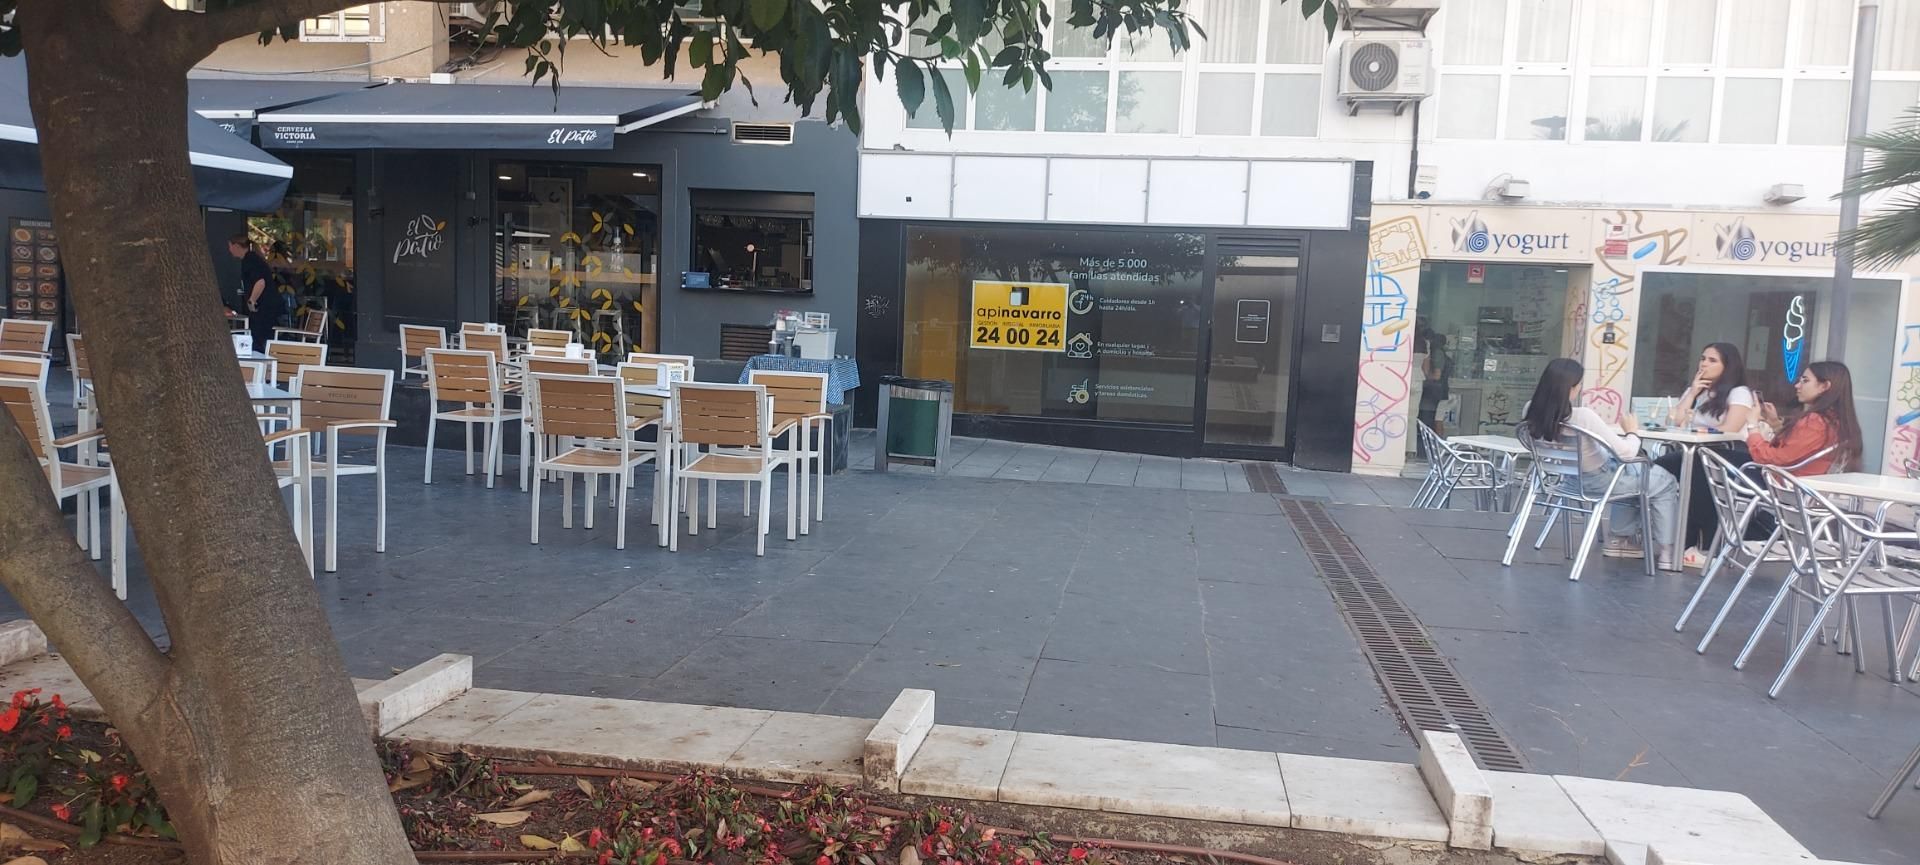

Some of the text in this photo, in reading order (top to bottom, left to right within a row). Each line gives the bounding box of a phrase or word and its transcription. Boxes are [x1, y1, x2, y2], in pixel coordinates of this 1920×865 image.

[274, 132, 316, 140] VICTORIA
[547, 127, 565, 144] El
[407, 217, 420, 236] El
[1492, 232, 1569, 254] yogurt
[1079, 257, 1100, 267] Más
[1103, 258, 1116, 268] de
[1069, 269, 1160, 282] familias atendidas
[976, 306, 1062, 320] apinavarro
[976, 326, 1060, 346] 24 00 24
[1095, 383, 1119, 391] Servicios
